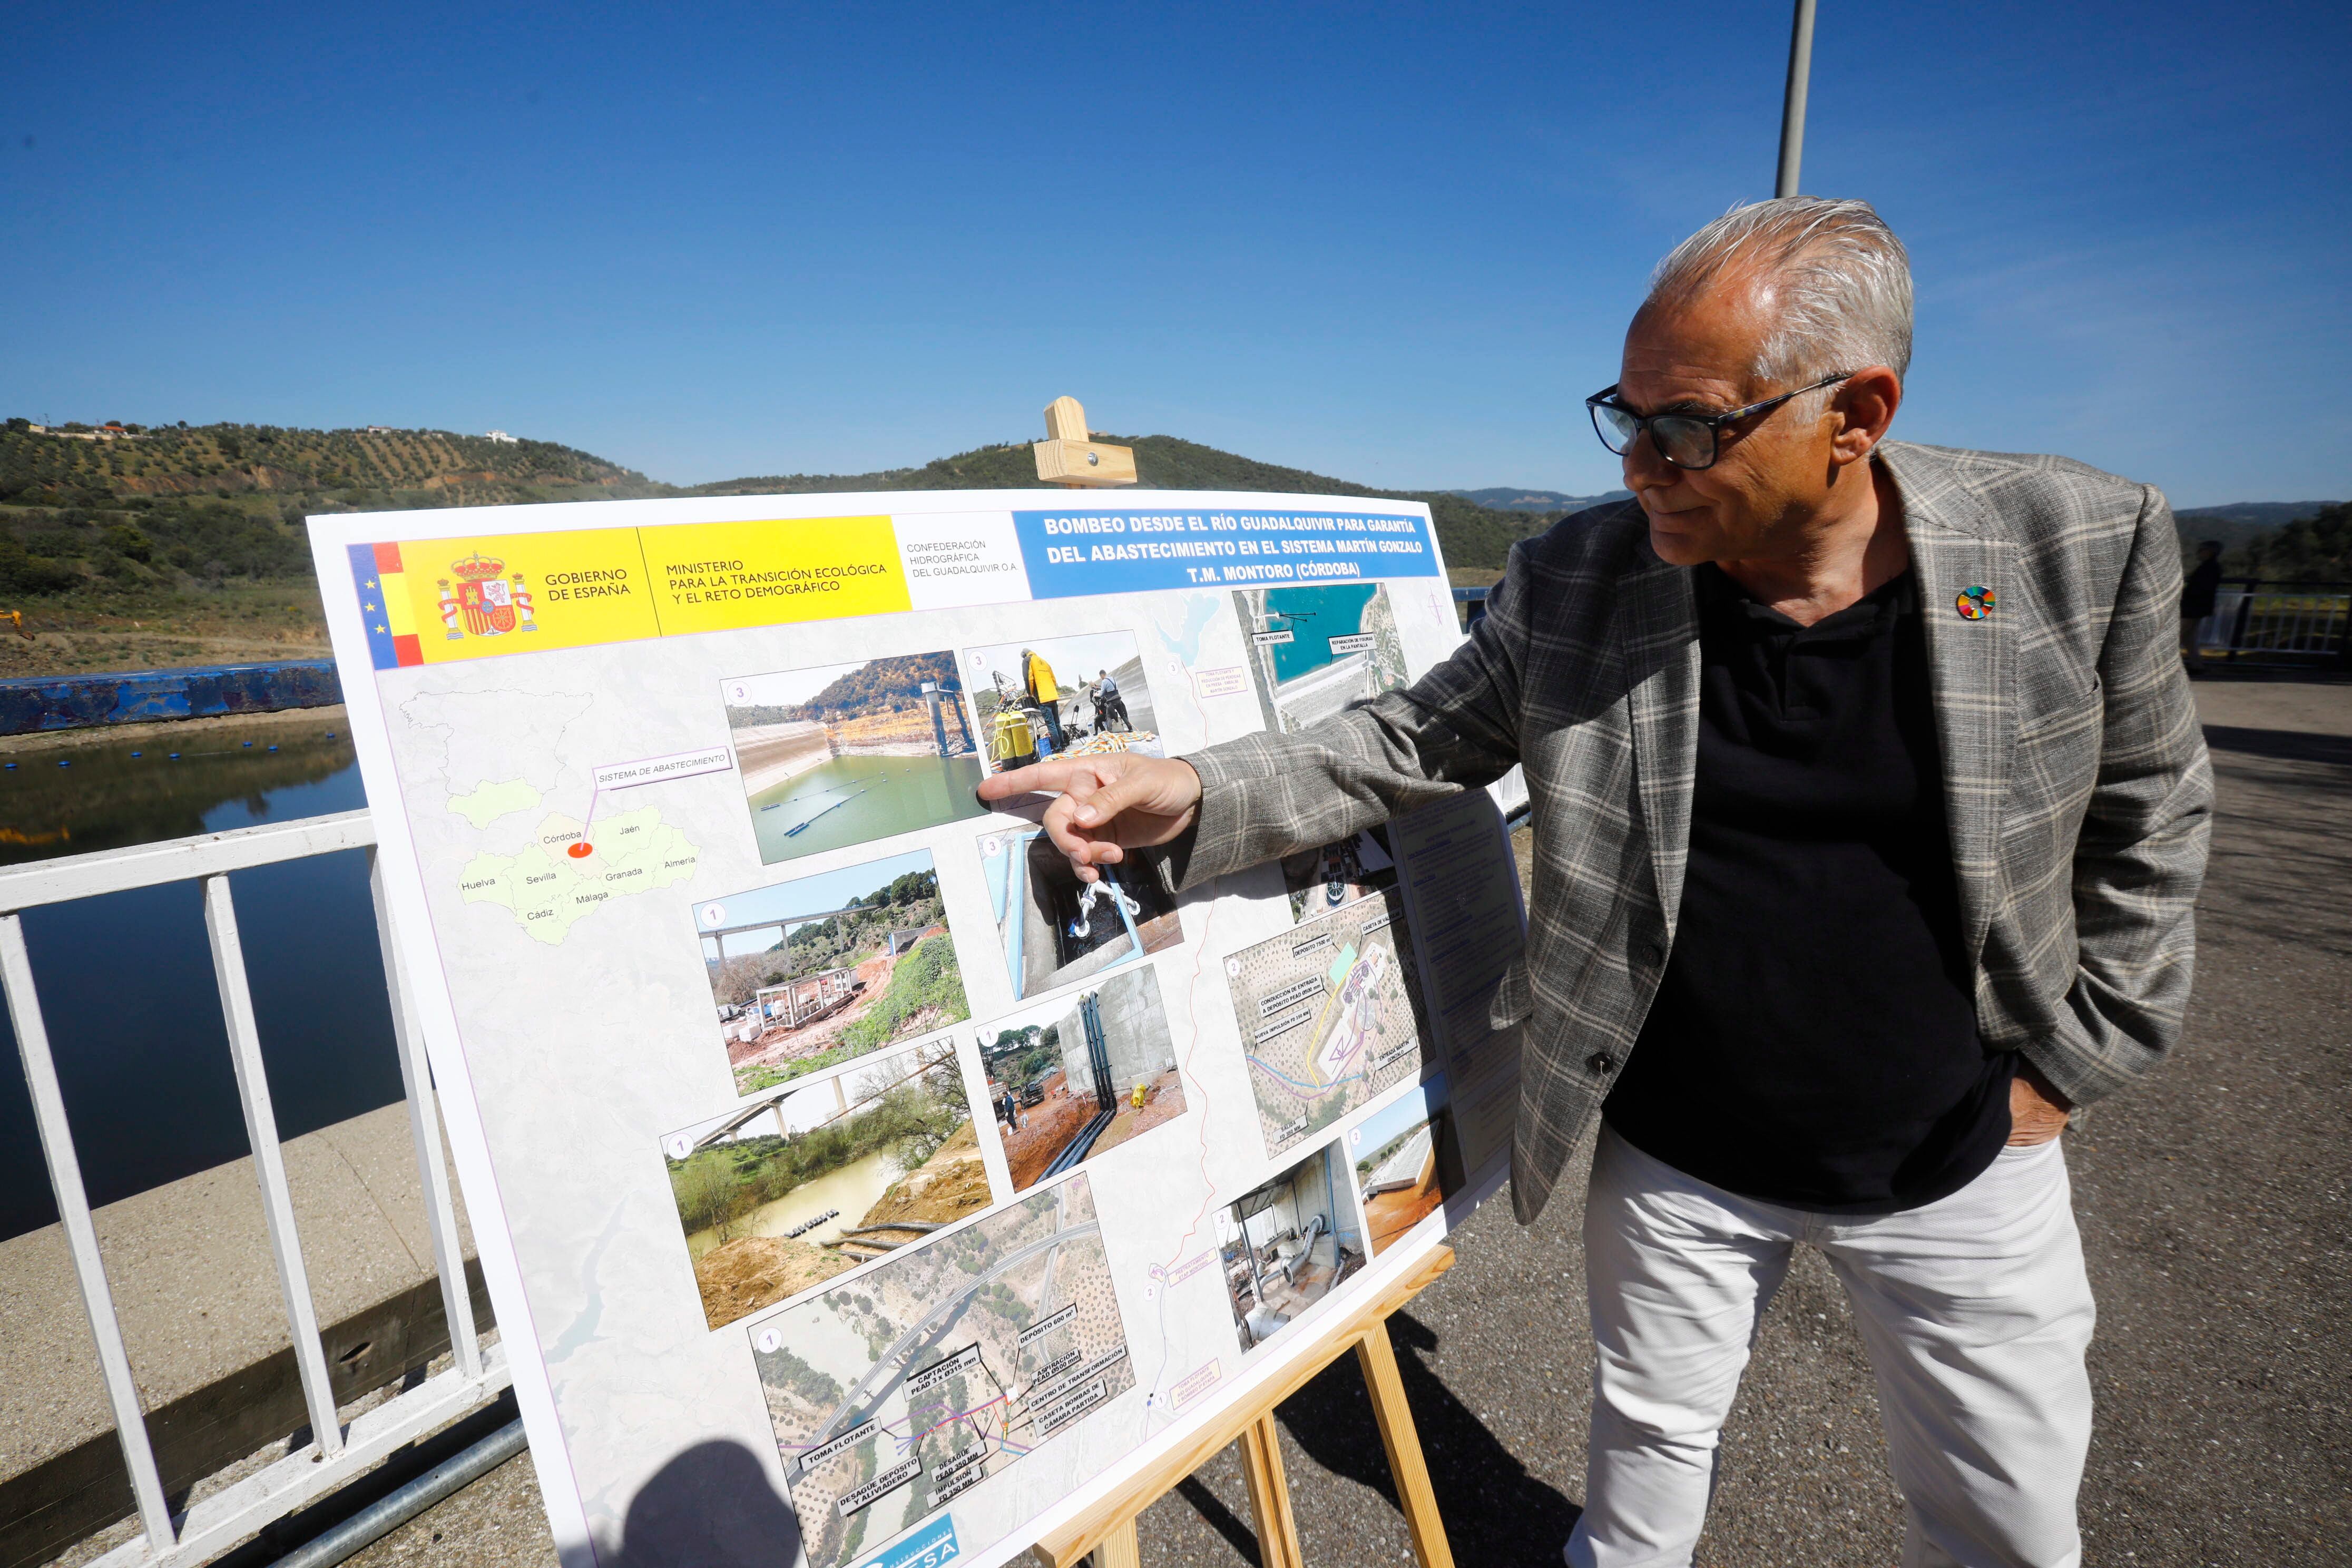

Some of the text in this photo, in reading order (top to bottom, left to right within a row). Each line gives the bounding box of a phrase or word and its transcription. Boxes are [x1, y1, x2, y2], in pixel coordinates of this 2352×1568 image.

[1044, 513, 1415, 535] BOMBEO DESDE EL RÍO GUADALQUIVIR PARA GARANTÍA
[907, 540, 986, 552] CONFEDERACIÓN
[1046, 537, 1422, 563] DEL ABASTECIMIENTO EN EL SISTEMA MARTÍN GONZALO
[910, 553, 980, 565] HIDROGRÁFICA
[667, 561, 743, 575] MINISTERIO
[933, 564, 999, 575] GUADALQUIVIR
[1187, 561, 1360, 582] T.M. MONTORO (CÓRDOBA)
[545, 569, 627, 585] GOBIERNO
[670, 564, 887, 590] PARA LA TRANSICIÓN ECOLÓGICA
[548, 582, 631, 601] DE ESPAÑA
[672, 581, 840, 604] Y EL RETO DEMOGRÁFICO
[975, 655, 983, 665] 3
[736, 687, 745, 699] 3
[599, 770, 637, 782] SISTEMA
[653, 754, 725, 772] ABASTECIMIENTO
[620, 825, 640, 835] Jaén
[543, 831, 582, 845] Córdoba
[988, 841, 996, 851] 3
[664, 856, 696, 869] Almería
[526, 873, 557, 885] Sevilla
[605, 867, 643, 881] Granada
[462, 878, 496, 891] Huelva
[576, 890, 609, 905] Málaga
[527, 909, 554, 920] Cádiz
[710, 909, 717, 921] 1
[1363, 923, 1377, 932] CASETA
[1295, 944, 1316, 956] DEPÓSITO
[1316, 939, 1326, 948] 7500
[1231, 962, 1238, 972] 2
[1261, 988, 1290, 1006] CONDUCCIÓN
[1298, 977, 1317, 989] ENTRADA
[1267, 998, 1289, 1011] DEPÓSITO
[1290, 993, 1301, 1001] PEAD
[986, 1031, 992, 1041] 1
[1255, 1031, 1269, 1039] NUEVA
[1270, 1020, 1290, 1032] IMPULSIÓN
[1379, 1048, 1396, 1061] ENTRADA
[1388, 1050, 1404, 1062] GONZALO
[1281, 1121, 1296, 1132] SALIDA
[1354, 1132, 1359, 1142] 2
[676, 1141, 684, 1152] 1
[1219, 1214, 1225, 1224] 2
[1148, 1288, 1153, 1297] 2
[1021, 1322, 1052, 1343] DEPÓSITO
[1054, 1317, 1064, 1325] 600
[766, 1334, 773, 1347] 1
[1033, 1372, 1050, 1385] PEAD
[1068, 1355, 1079, 1364] mm
[1037, 1350, 1075, 1376] ASPIRACIÓN
[911, 1382, 930, 1395] PEAD
[964, 1357, 976, 1366] mm
[918, 1358, 959, 1384] CAPTACIÓN
[1031, 1348, 1123, 1407] CENTRO DE TRANSFORMACIÓN
[1039, 1383, 1100, 1424] CASETA BOMBAS DE
[1044, 1394, 1098, 1429] CÁMARA PARTIDA
[809, 1424, 876, 1463] TOMA FLOTANTE
[935, 1452, 978, 1482] PEAD 350 MM
[840, 1458, 917, 1506] DESAGÜE DEPÓSITO
[862, 1472, 908, 1502] ALIVIADERO
[939, 1478, 973, 1503] FD 350 MM
